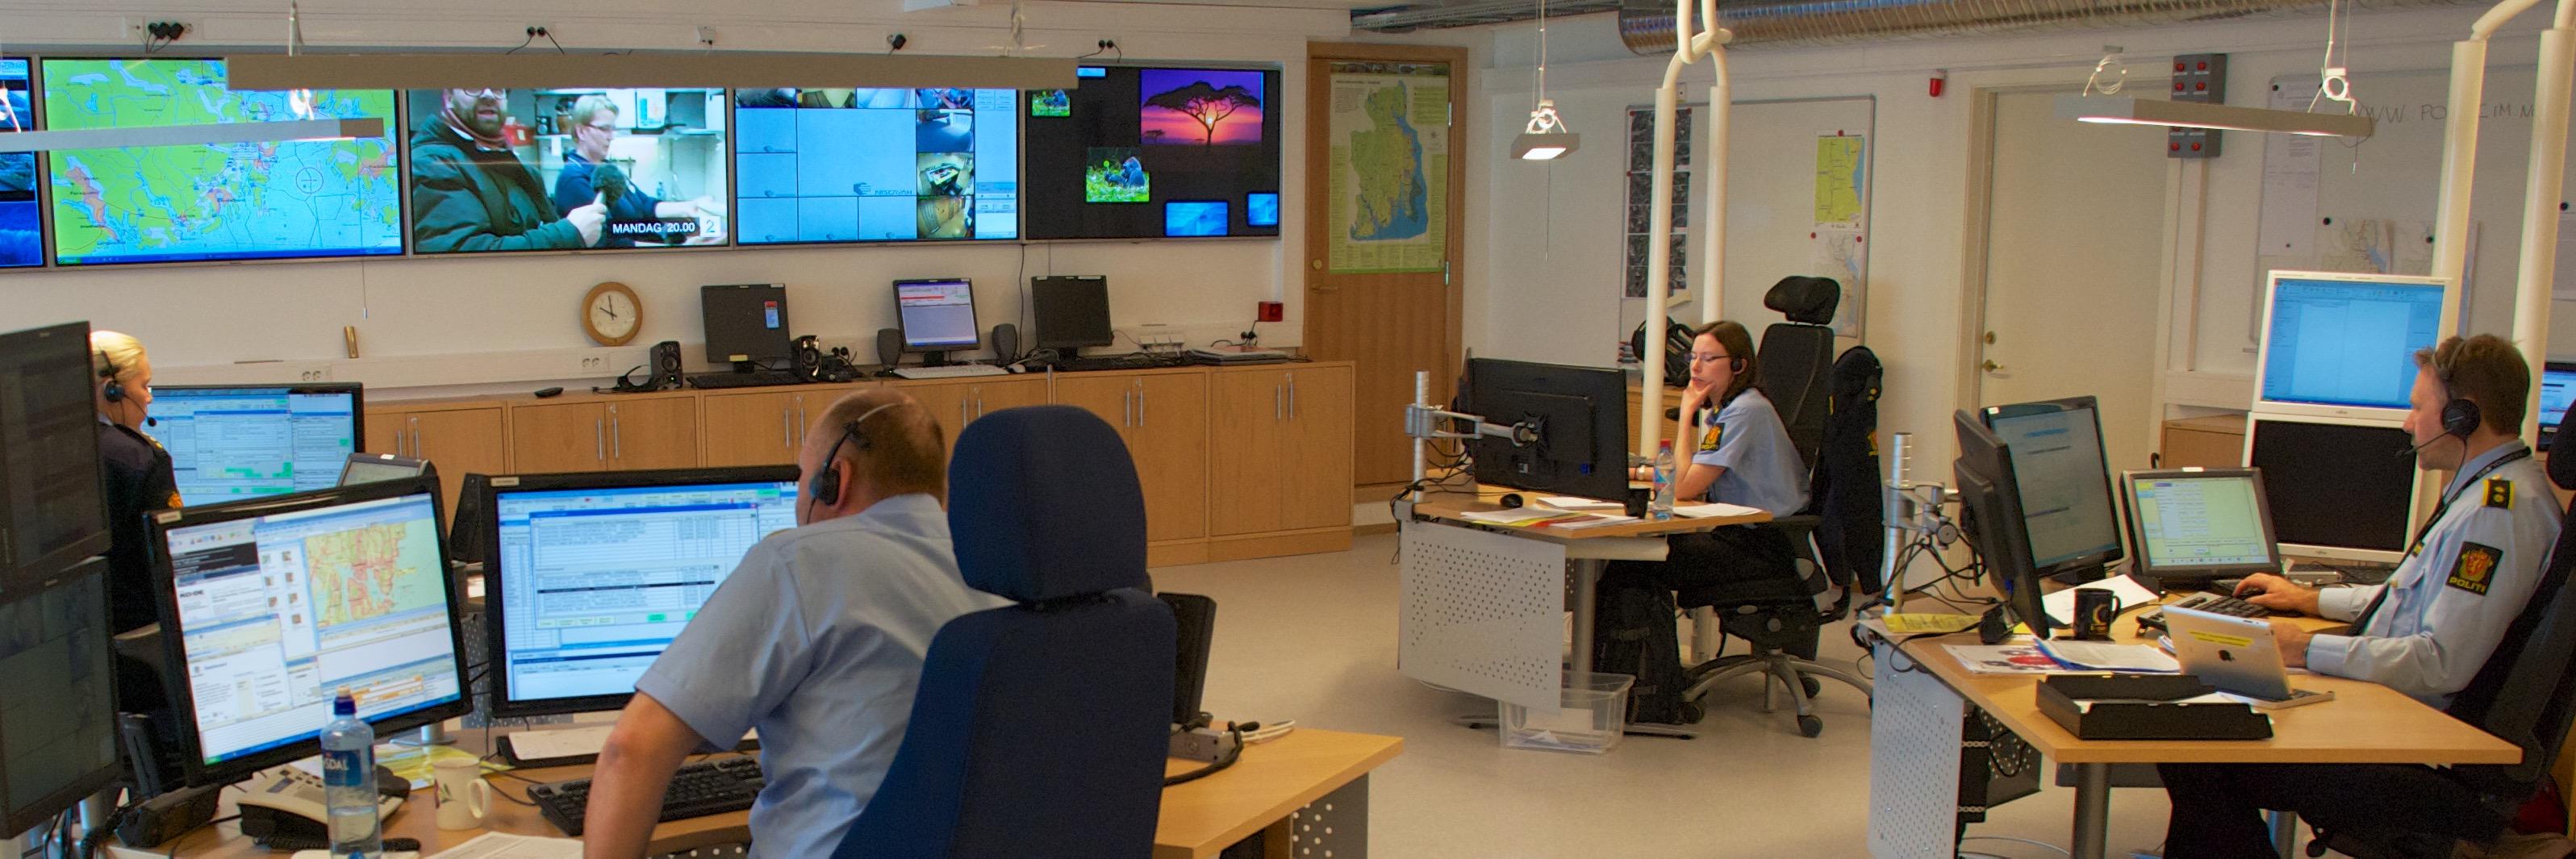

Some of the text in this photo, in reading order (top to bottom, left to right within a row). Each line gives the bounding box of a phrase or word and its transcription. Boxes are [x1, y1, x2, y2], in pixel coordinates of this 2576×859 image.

[612, 222, 695, 234] MANDAG 20.00
[705, 219, 716, 233] 2
[2449, 577, 2486, 593] POLITI
